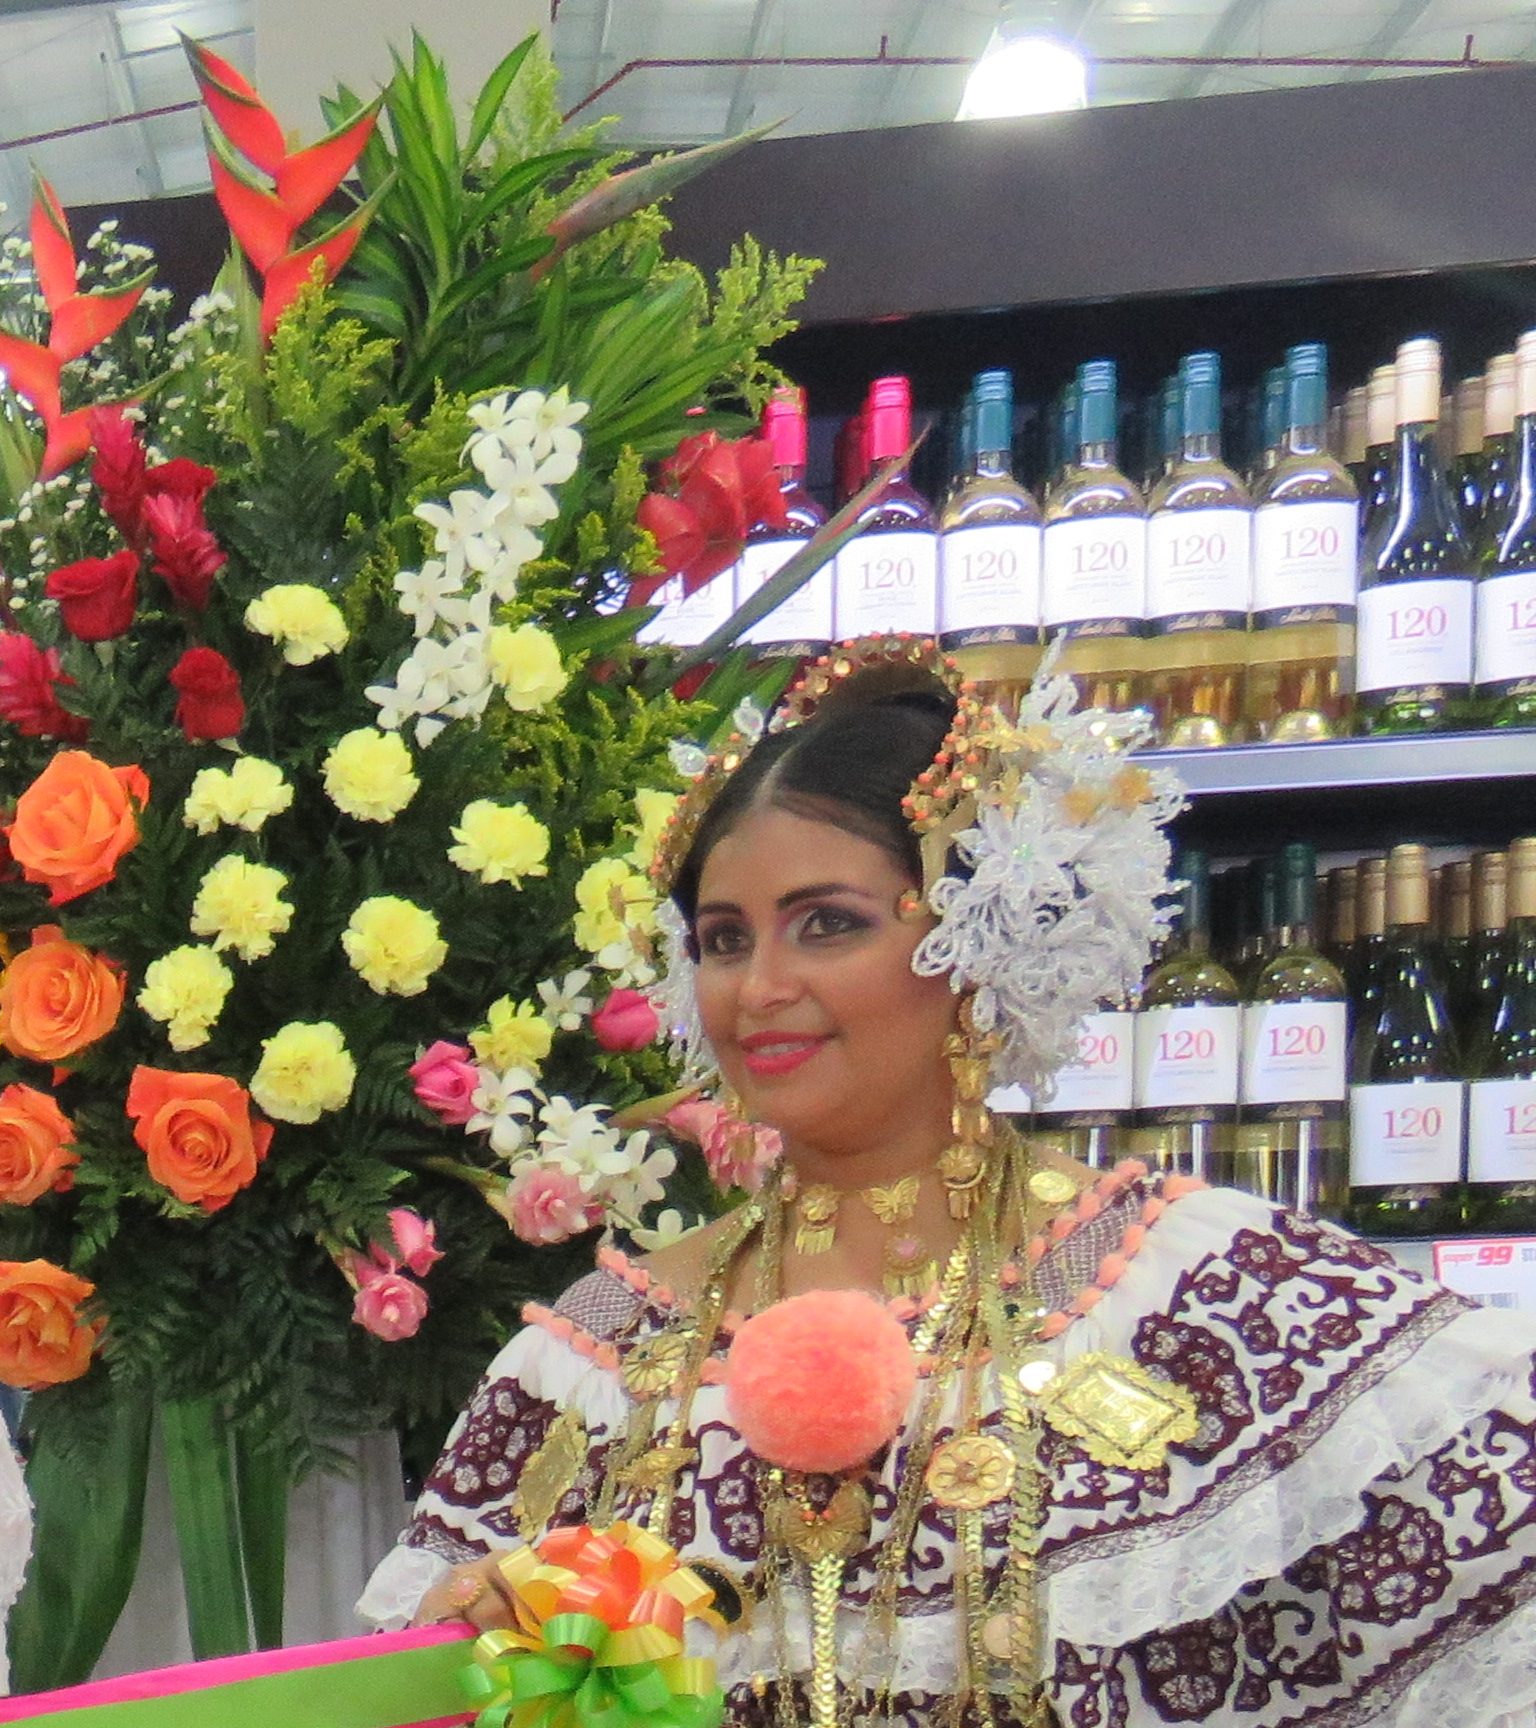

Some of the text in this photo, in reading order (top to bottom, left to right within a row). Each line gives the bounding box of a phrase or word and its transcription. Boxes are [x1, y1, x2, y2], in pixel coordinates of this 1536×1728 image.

[1072, 540, 1128, 575] 120
[1168, 533, 1226, 568] 120
[1281, 526, 1339, 560] 120
[860, 557, 915, 591] 120
[961, 548, 1017, 583] 120
[1387, 605, 1448, 641] 120
[1079, 1034, 1119, 1065] 20
[1158, 1028, 1215, 1062] 120
[1268, 1024, 1326, 1057] 120
[1383, 1106, 1442, 1139] 120
[1504, 1103, 1536, 1135] 12
[1476, 1246, 1513, 1266] 99
